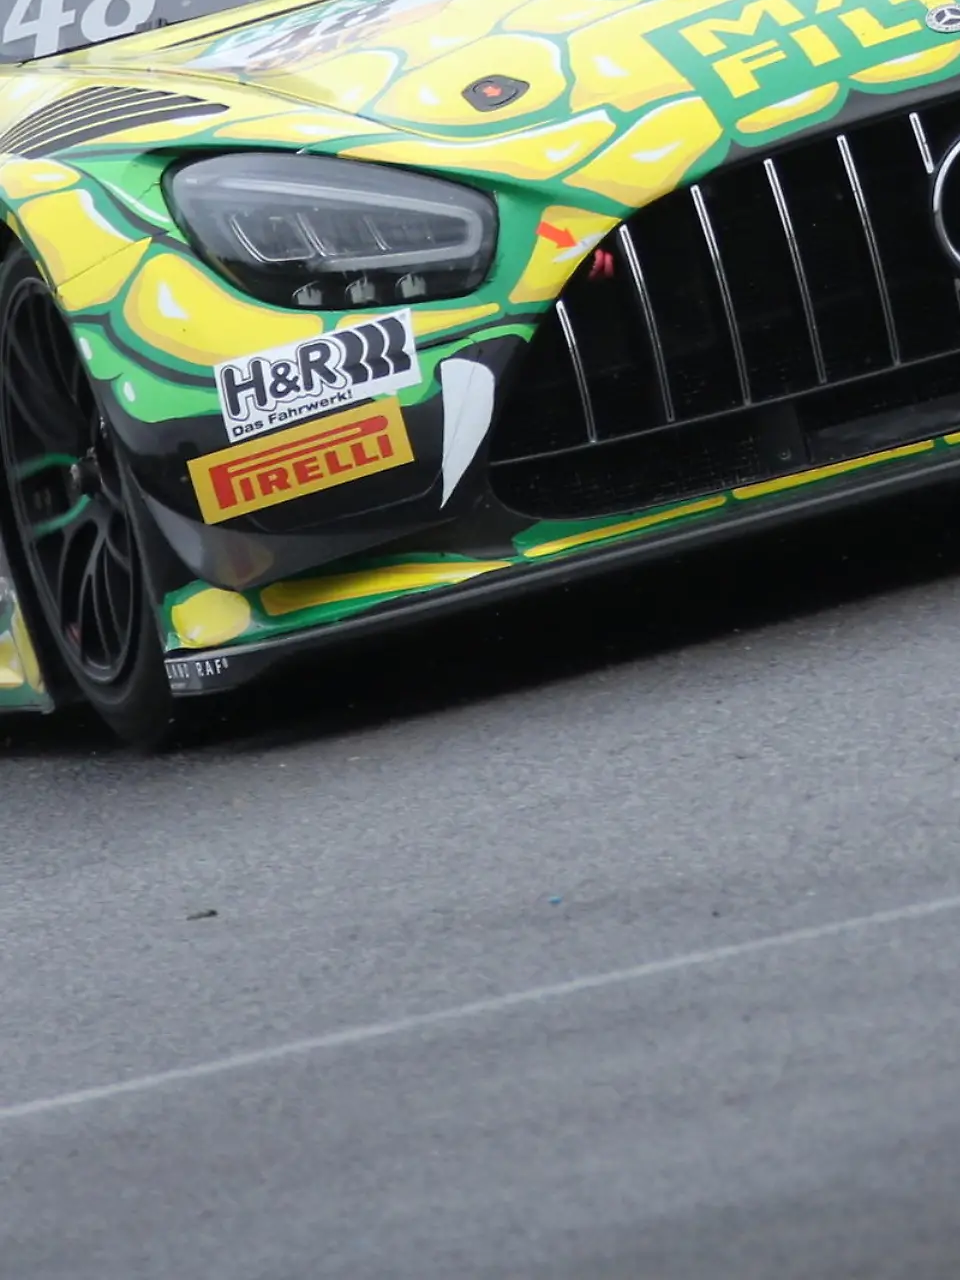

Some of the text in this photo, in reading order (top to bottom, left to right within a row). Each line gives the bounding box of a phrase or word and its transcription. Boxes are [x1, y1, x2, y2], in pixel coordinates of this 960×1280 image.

[222, 339, 343, 419] H&R
[232, 390, 353, 438] Das Fahrwerk!
[208, 415, 394, 510] PIRELLI
